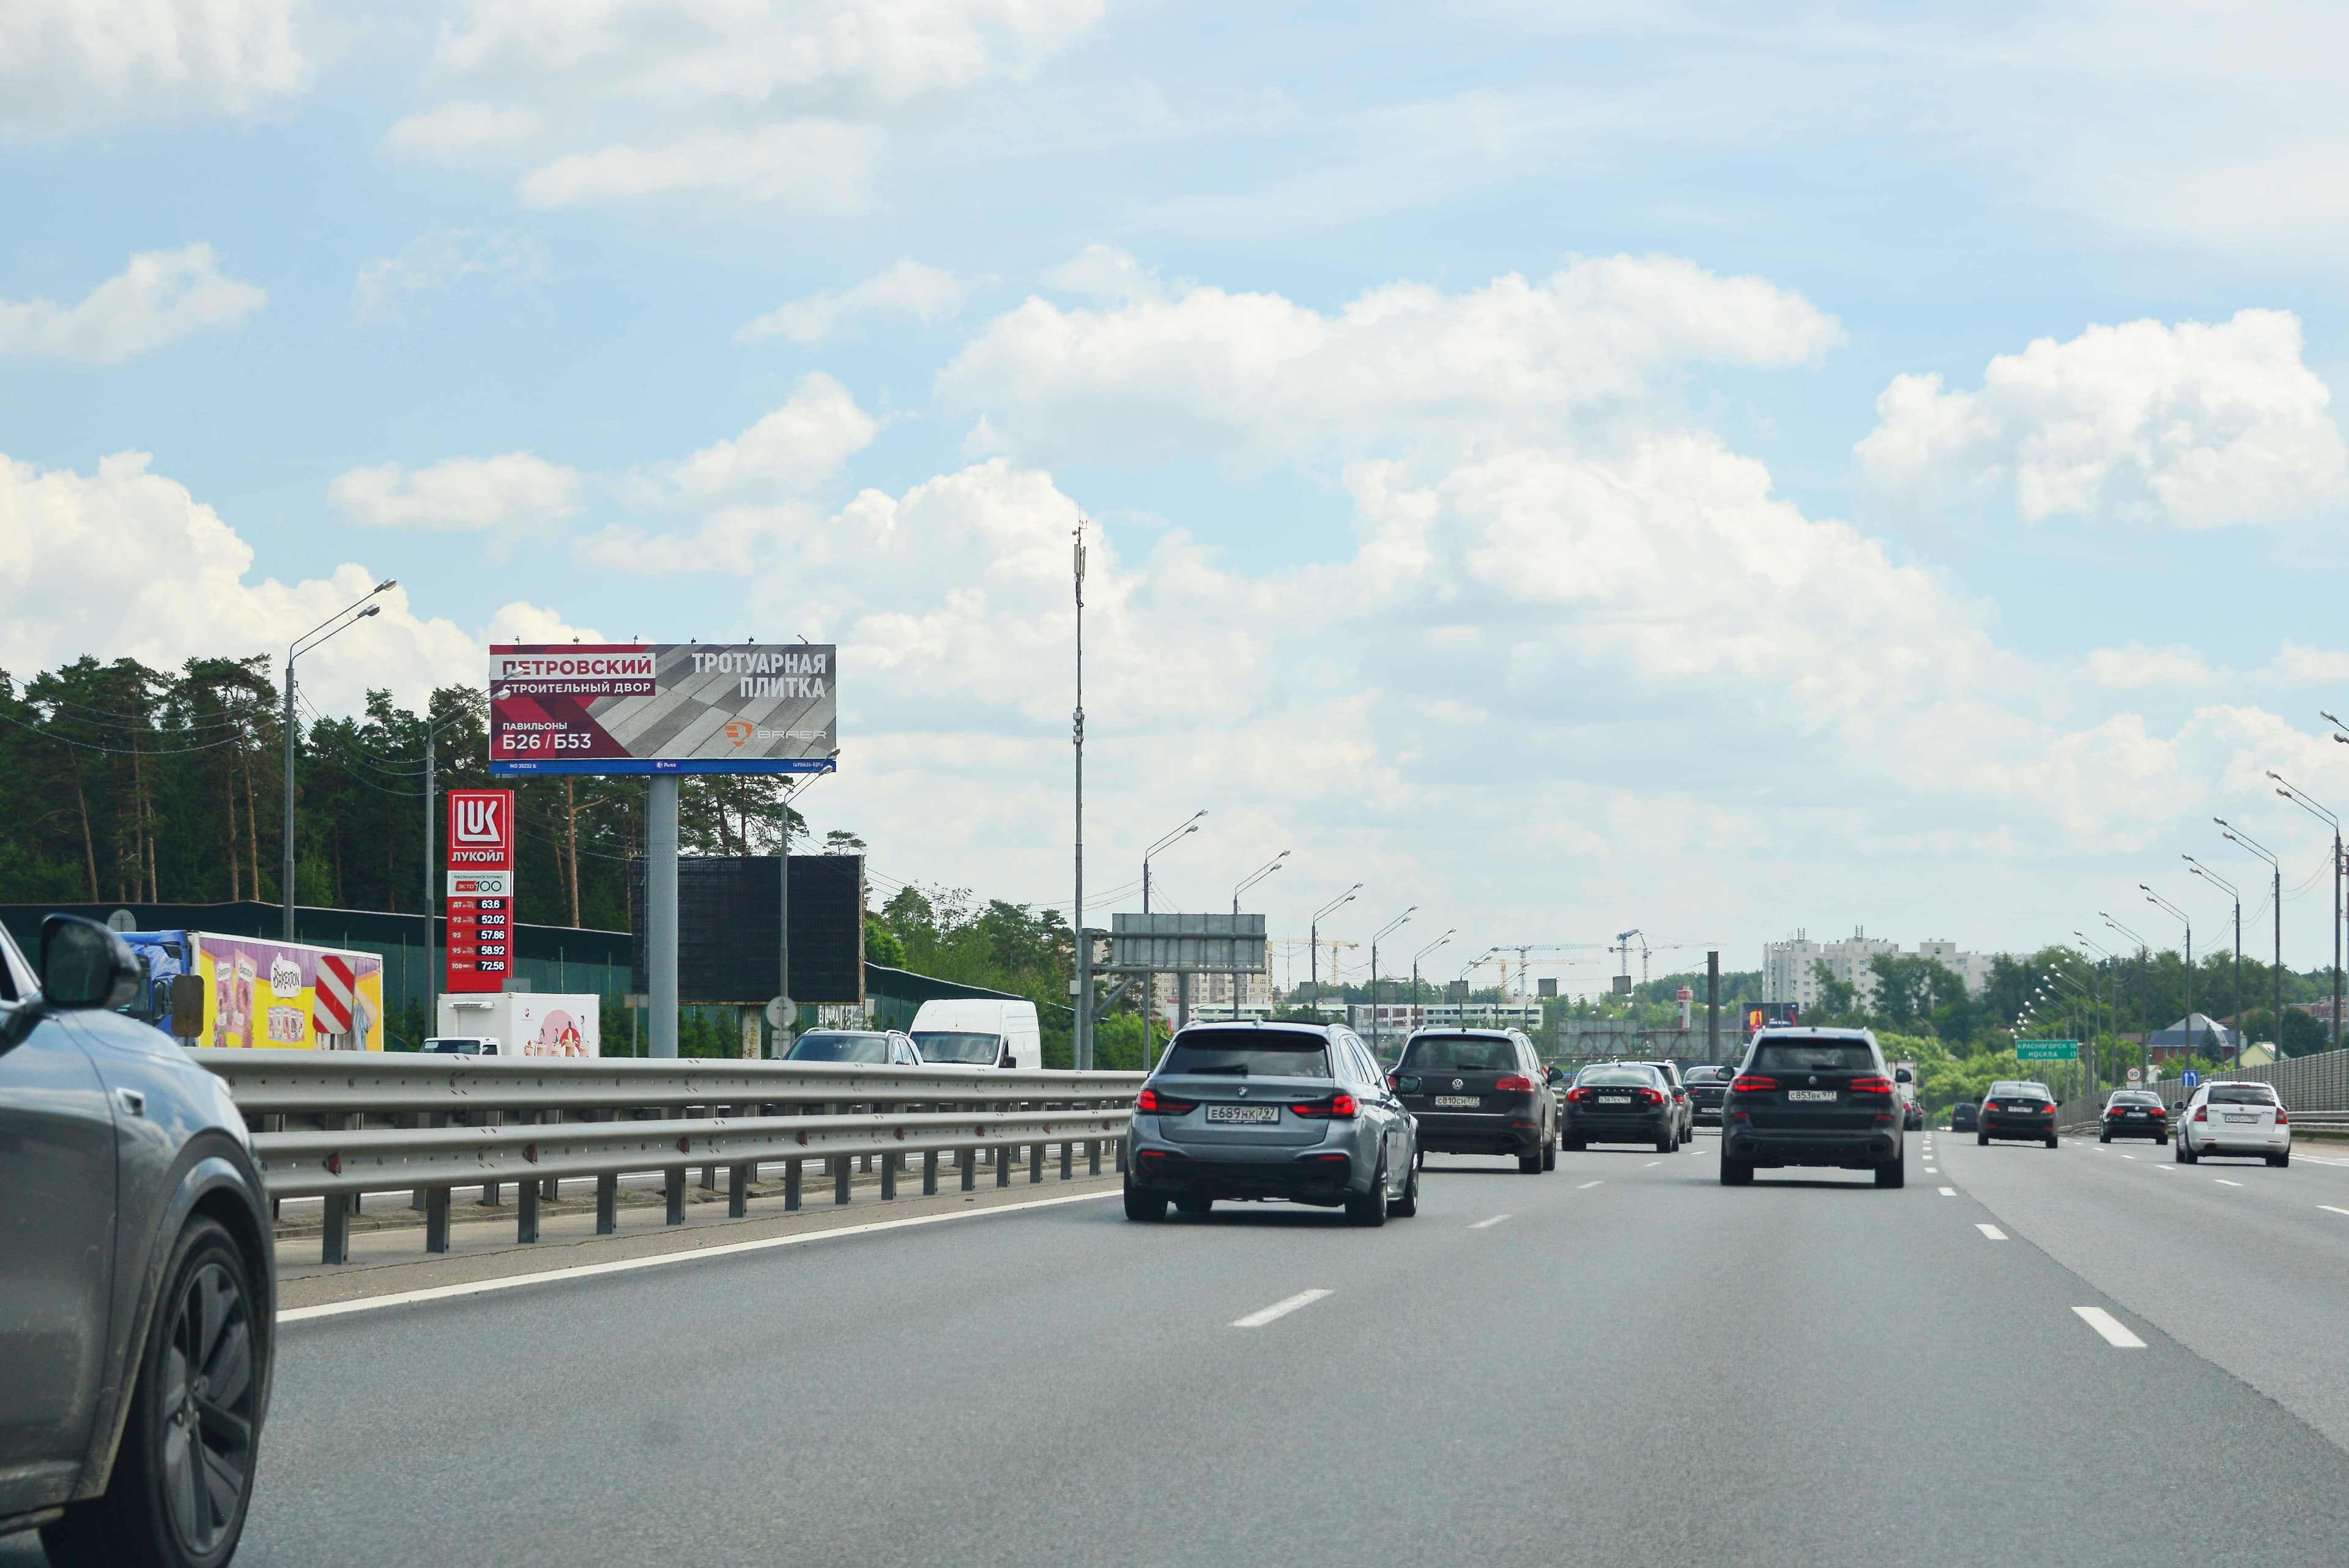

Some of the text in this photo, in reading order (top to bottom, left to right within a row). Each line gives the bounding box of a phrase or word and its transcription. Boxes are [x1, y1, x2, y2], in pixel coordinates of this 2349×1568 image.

[502, 656, 651, 675] ПЕТРОВСКИЙ
[692, 653, 826, 674] ТРОТУАРНАЯ
[503, 681, 651, 694] СТРОИТЕЛЬНЫЙ ДВОР
[740, 677, 826, 697] ПЛИТКА
[757, 730, 826, 739] BRAER
[503, 734, 541, 749] Б26
[554, 734, 592, 749] Б53
[451, 849, 504, 862] ЛУКОЙЛ
[481, 900, 500, 909] 63.6
[481, 915, 505, 924] 52.02
[481, 931, 505, 940] 57.86
[481, 946, 505, 955] 58.92
[481, 961, 505, 970] 72.58
[1258, 1107, 1275, 1116] 797
